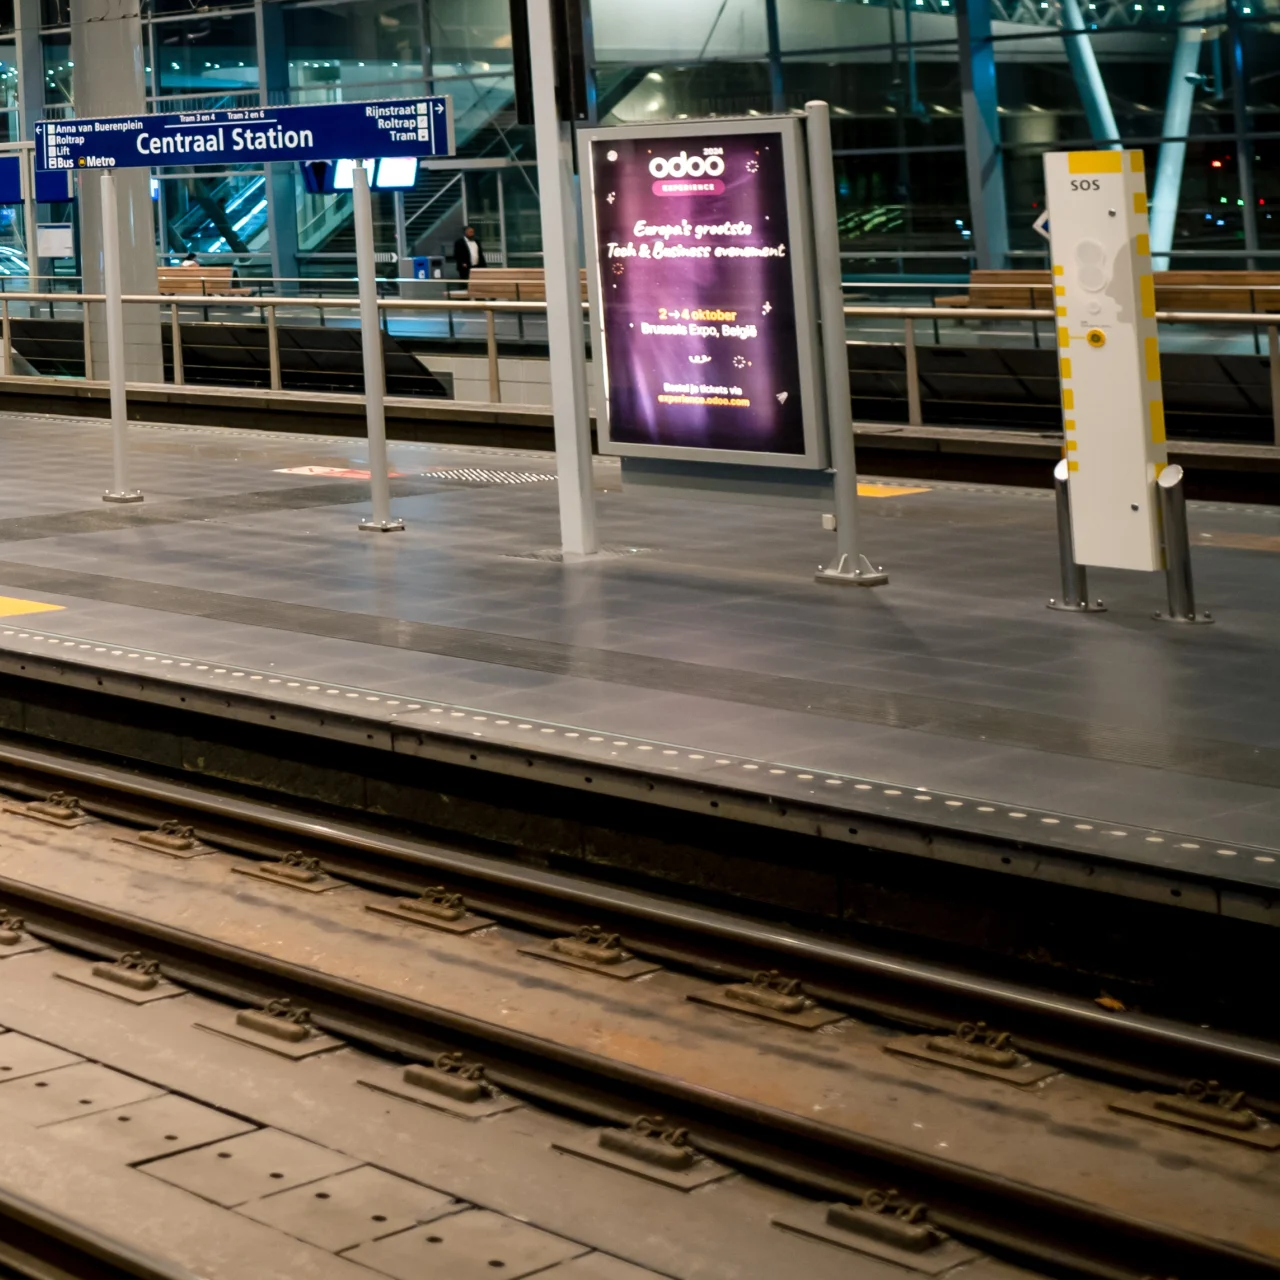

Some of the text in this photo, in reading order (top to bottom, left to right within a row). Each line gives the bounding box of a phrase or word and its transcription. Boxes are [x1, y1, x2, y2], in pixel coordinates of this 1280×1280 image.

[179, 114, 196, 123] Tram
[201, 114, 210, 122] en
[227, 111, 243, 120] Tram
[366, 105, 416, 119] Rijnstraat
[56, 120, 143, 134] Anna van Buerenplein
[378, 118, 416, 130] Roltrap
[56, 135, 85, 146] Roltrap
[136, 124, 314, 155] Centraal Station
[390, 131, 416, 141] Tram
[56, 146, 70, 156] Lift
[57, 155, 116, 168] Bus Metro
[648, 150, 725, 179] odoo
[661, 183, 715, 192] EXPERIENCE
[1070, 179, 1101, 192] SOS
[633, 219, 752, 240] Europa's grootste
[606, 240, 786, 260] Tech & Business evenement
[659, 308, 738, 322] 2 4 oktober
[640, 321, 758, 340] Brussels Expo, België
[699, 384, 729, 395] tickets
[729, 386, 743, 396] via
[657, 394, 751, 407] experience.odoo.com
